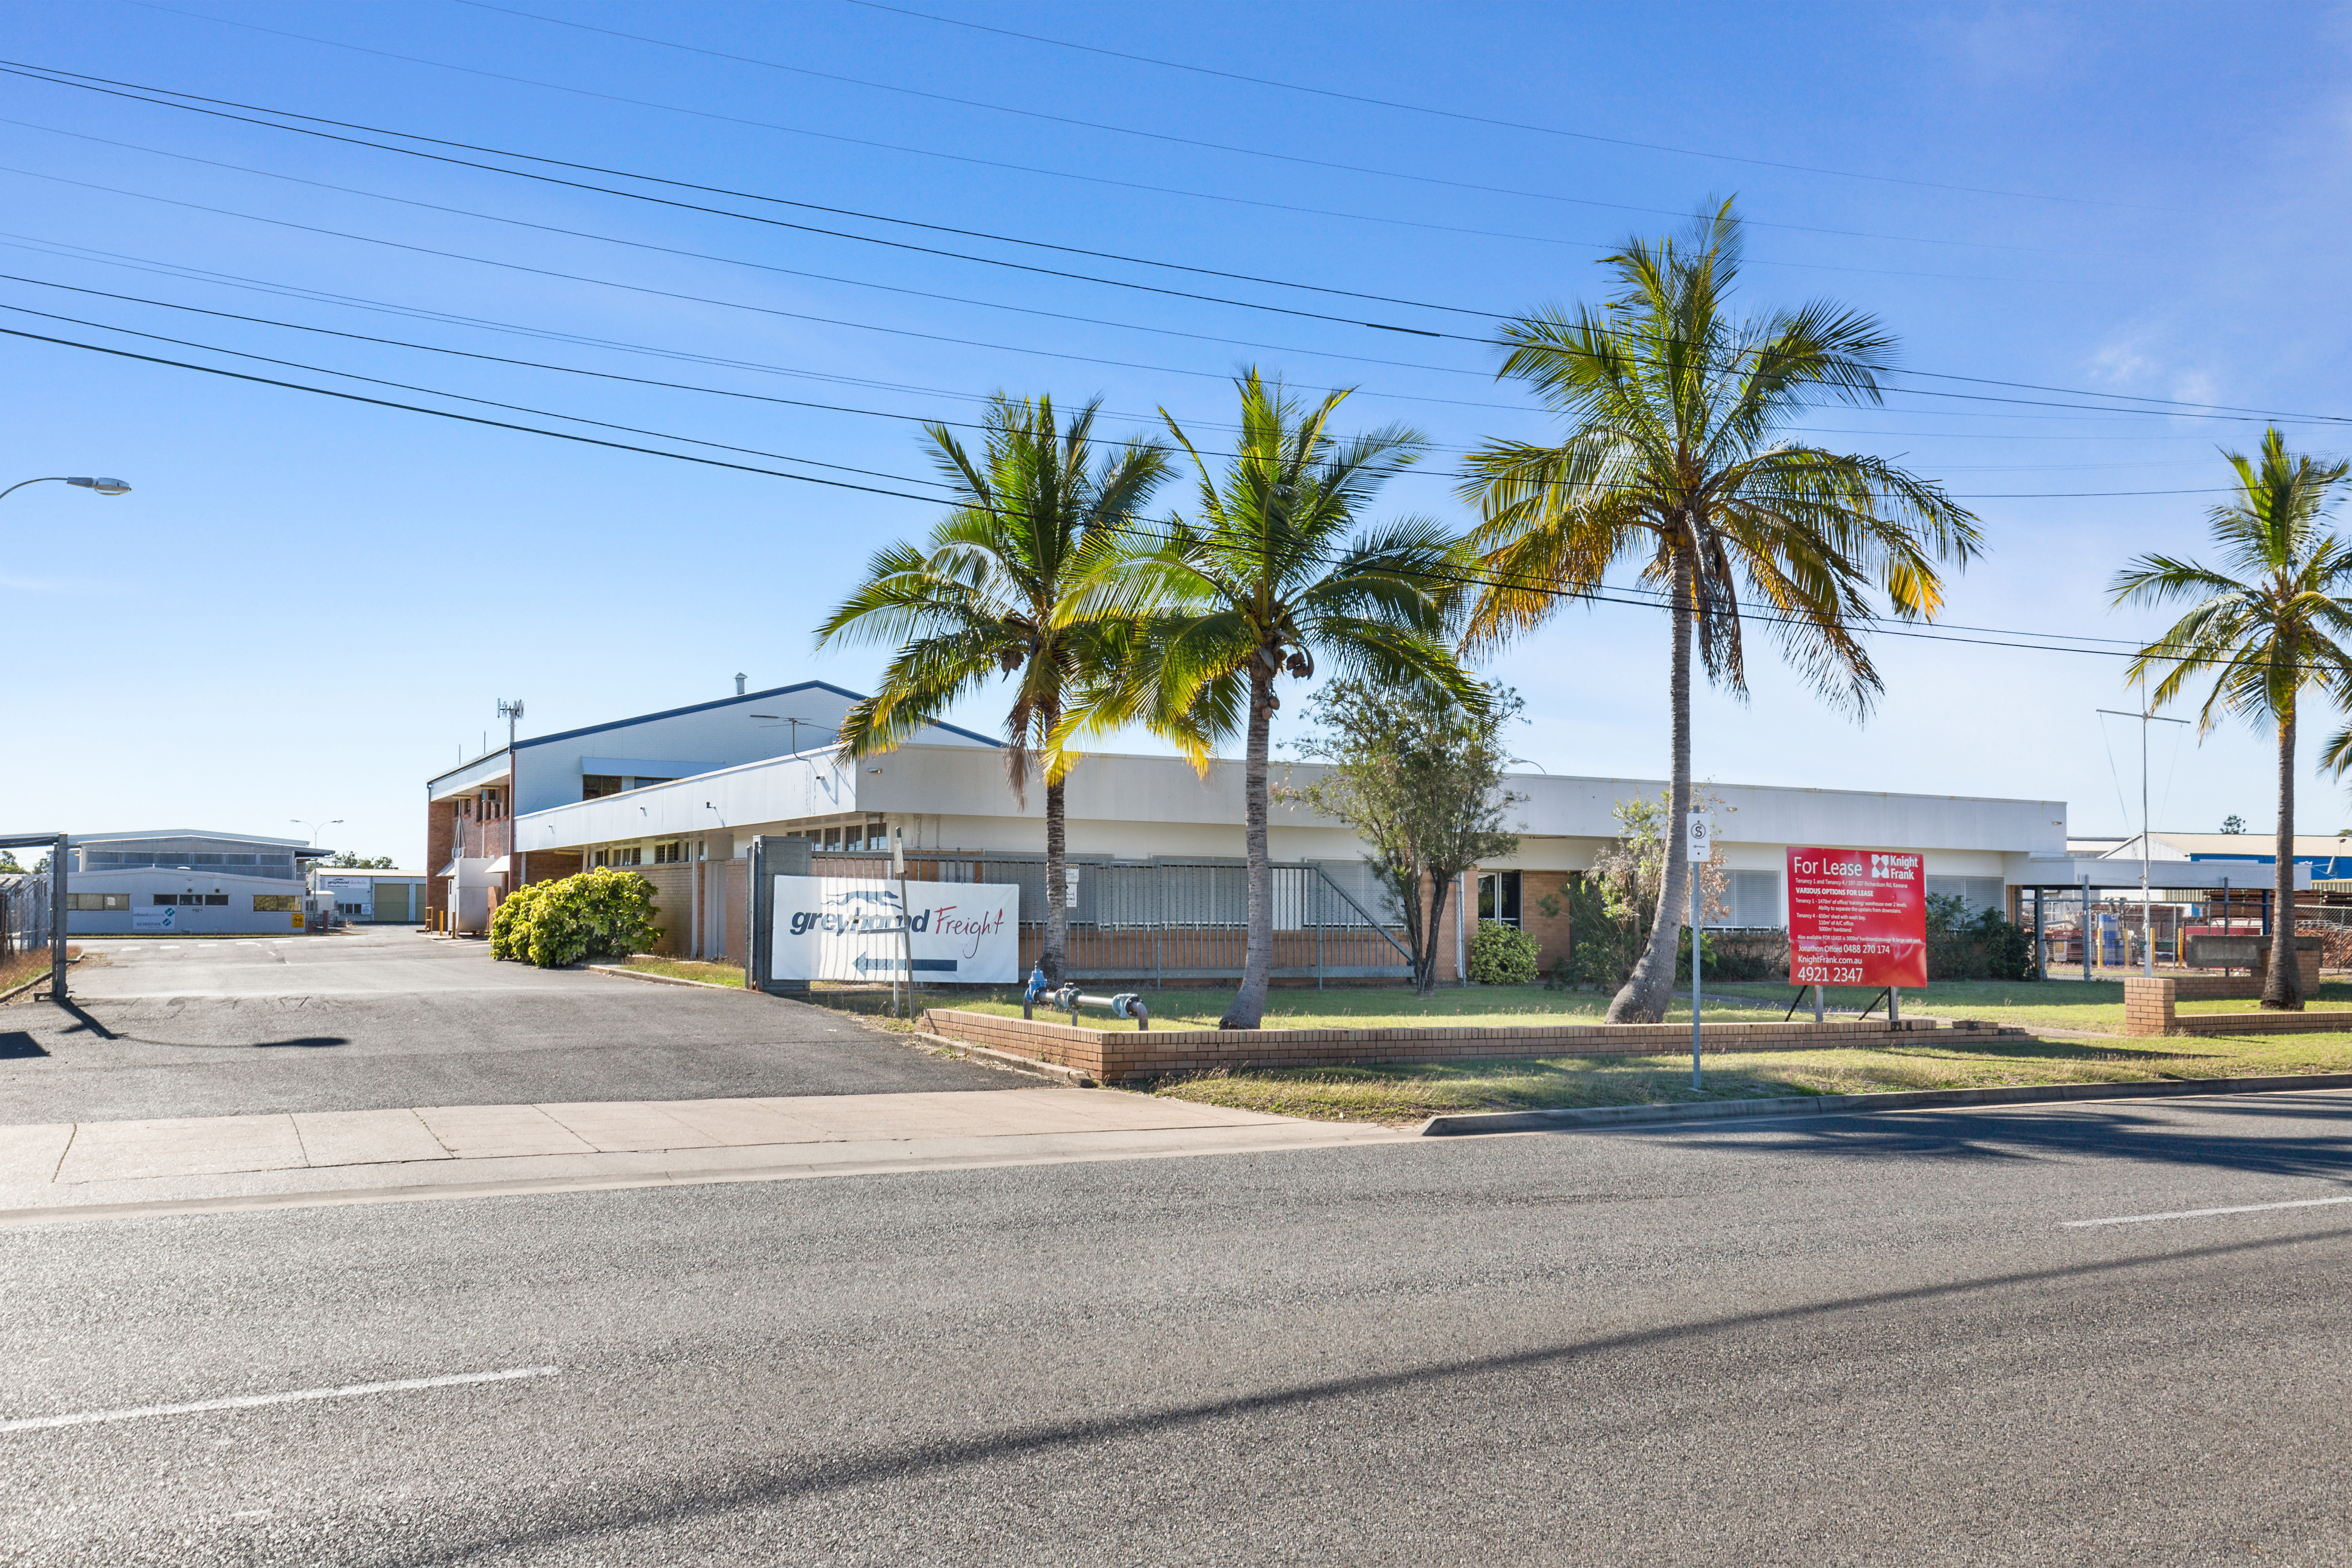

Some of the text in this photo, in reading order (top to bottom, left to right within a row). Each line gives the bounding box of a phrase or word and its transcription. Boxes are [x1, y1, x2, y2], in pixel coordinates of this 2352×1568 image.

[1794, 856, 1862, 877] For Lease
[1890, 856, 1918, 870] Knight
[1891, 868, 1914, 880] Frank
[933, 906, 1004, 959] Freight
[1844, 944, 1861, 953] 0488
[1862, 945, 1875, 953] 270
[1877, 945, 1890, 954] 174
[1798, 955, 1862, 965] KnightFrank.com.au
[1798, 967, 1863, 982] 4921 2347
